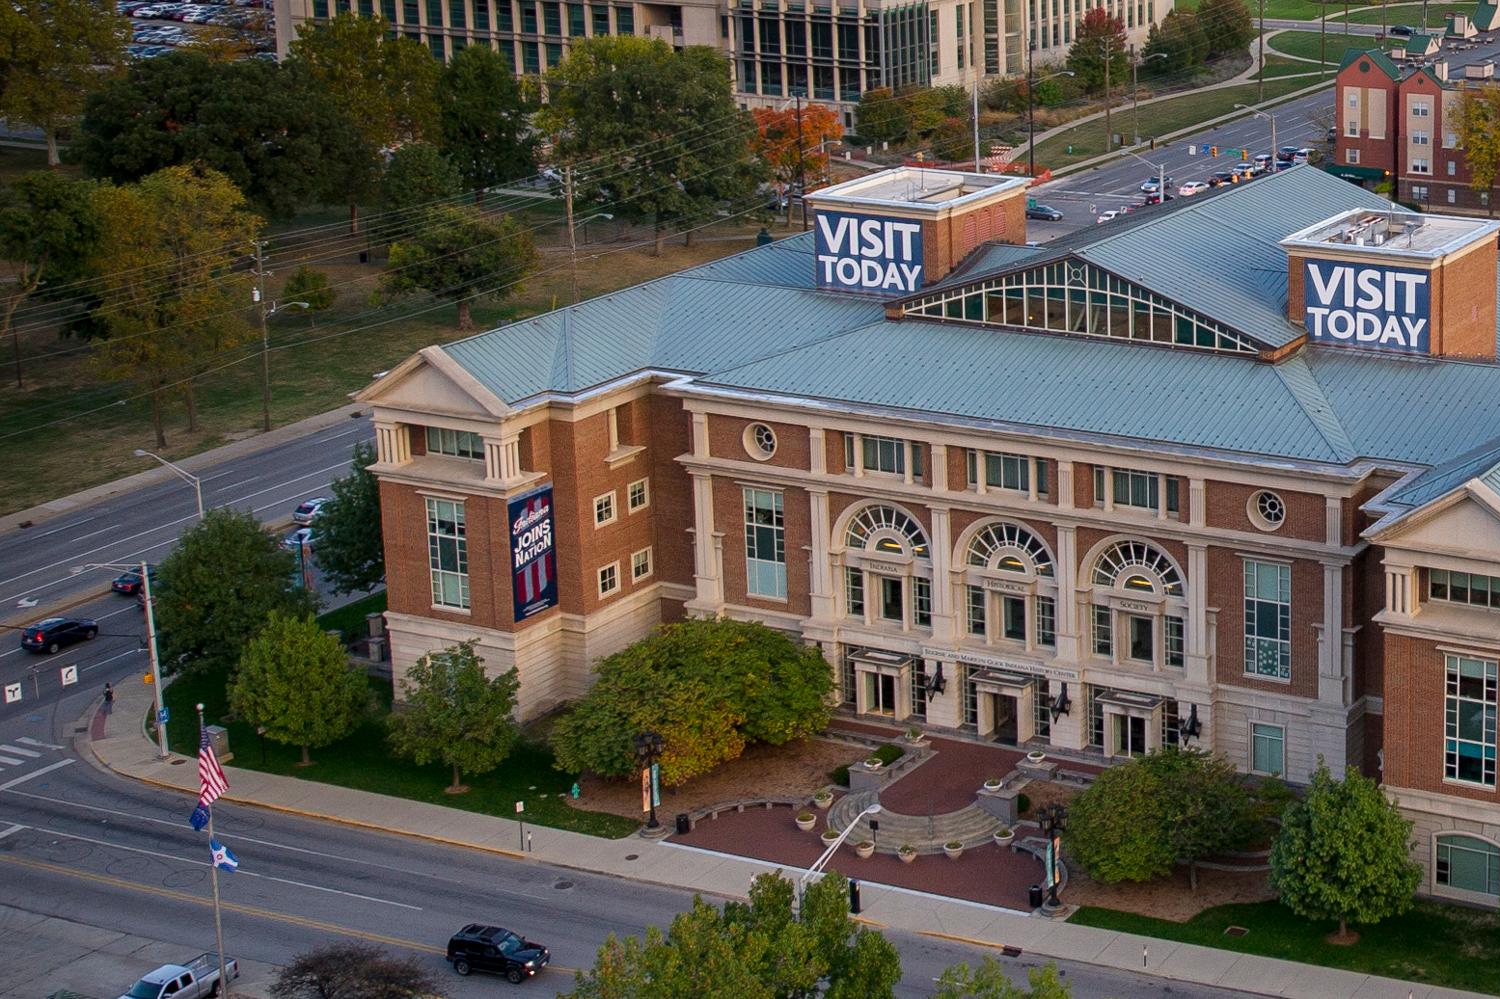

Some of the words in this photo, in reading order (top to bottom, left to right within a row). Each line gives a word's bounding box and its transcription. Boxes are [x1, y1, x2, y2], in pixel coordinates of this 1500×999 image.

[817, 214, 920, 261] VISIT
[818, 255, 921, 291] TODAY
[1307, 263, 1427, 314] VISIT
[1307, 307, 1427, 347] TODAY
[514, 518, 551, 553] JOINS
[515, 533, 552, 568] NATION
